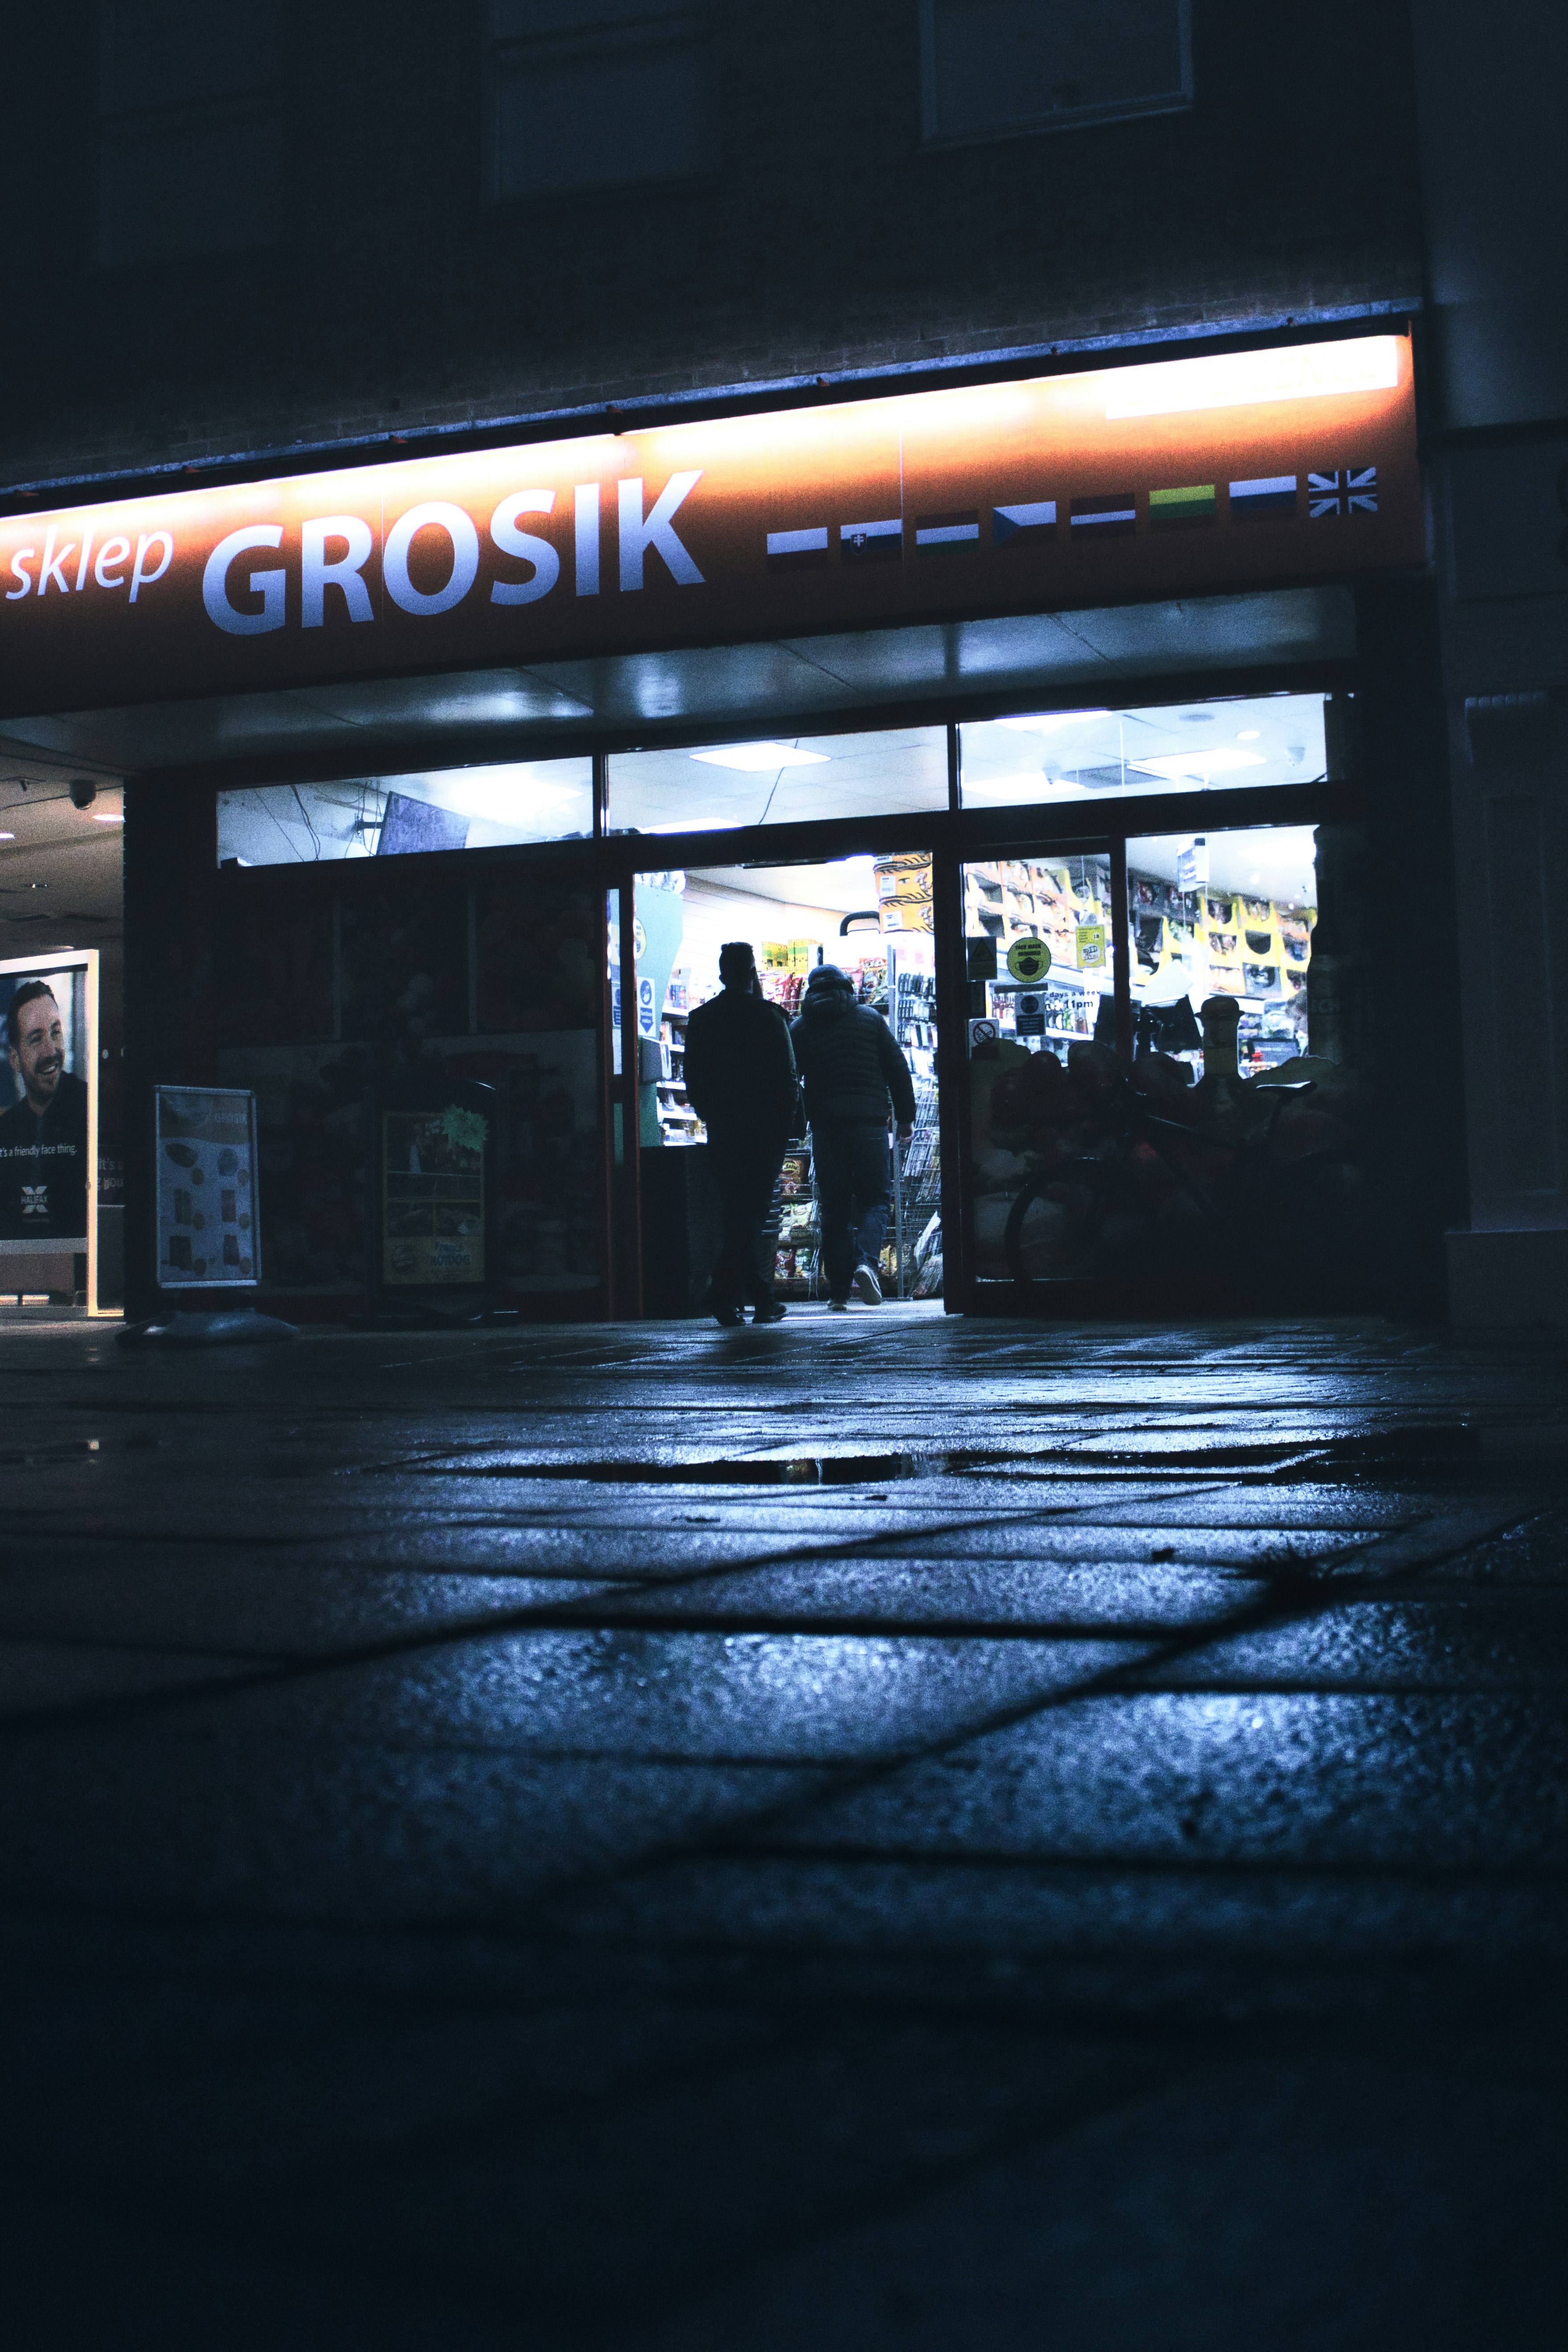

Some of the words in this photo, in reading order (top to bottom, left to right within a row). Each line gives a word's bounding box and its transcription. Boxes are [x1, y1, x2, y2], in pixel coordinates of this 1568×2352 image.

[5, 524, 173, 603] sklep
[203, 470, 706, 636] GROSIK
[1064, 1000, 1093, 1009] 11pm
[15, 1145, 39, 1158] friendly
[41, 1144, 56, 1155] face
[57, 1143, 77, 1156] thing.
